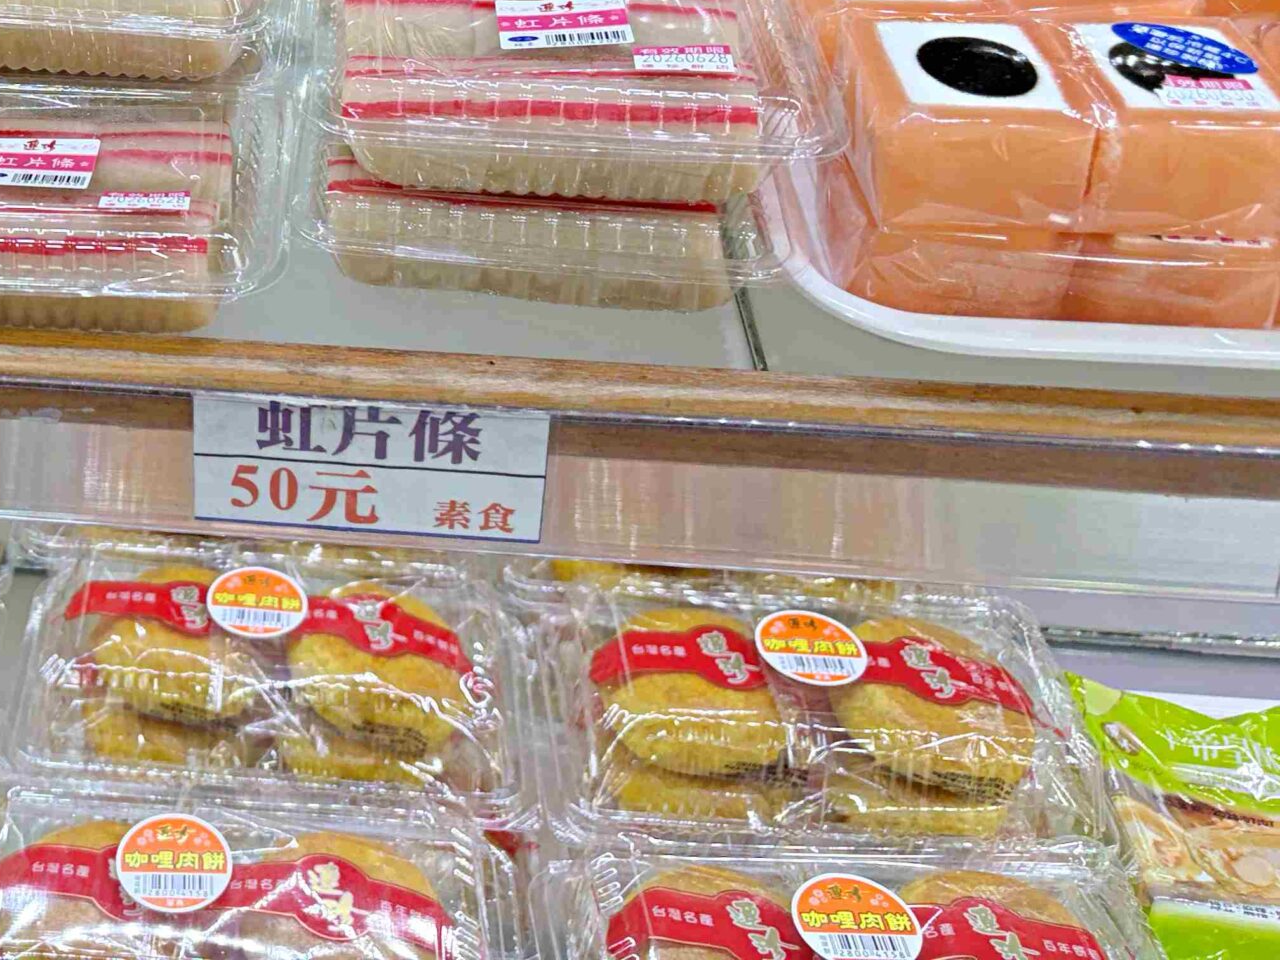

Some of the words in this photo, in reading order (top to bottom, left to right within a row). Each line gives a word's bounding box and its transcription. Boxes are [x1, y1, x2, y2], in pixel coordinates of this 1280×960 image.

[513, 15, 605, 29] 虹片條
[255, 400, 483, 465] 虹片條
[230, 464, 380, 525] 50元
[432, 499, 517, 534] 素食
[123, 850, 225, 871] 咖哩肉餅
[800, 909, 913, 932] 咖哩肉餅
